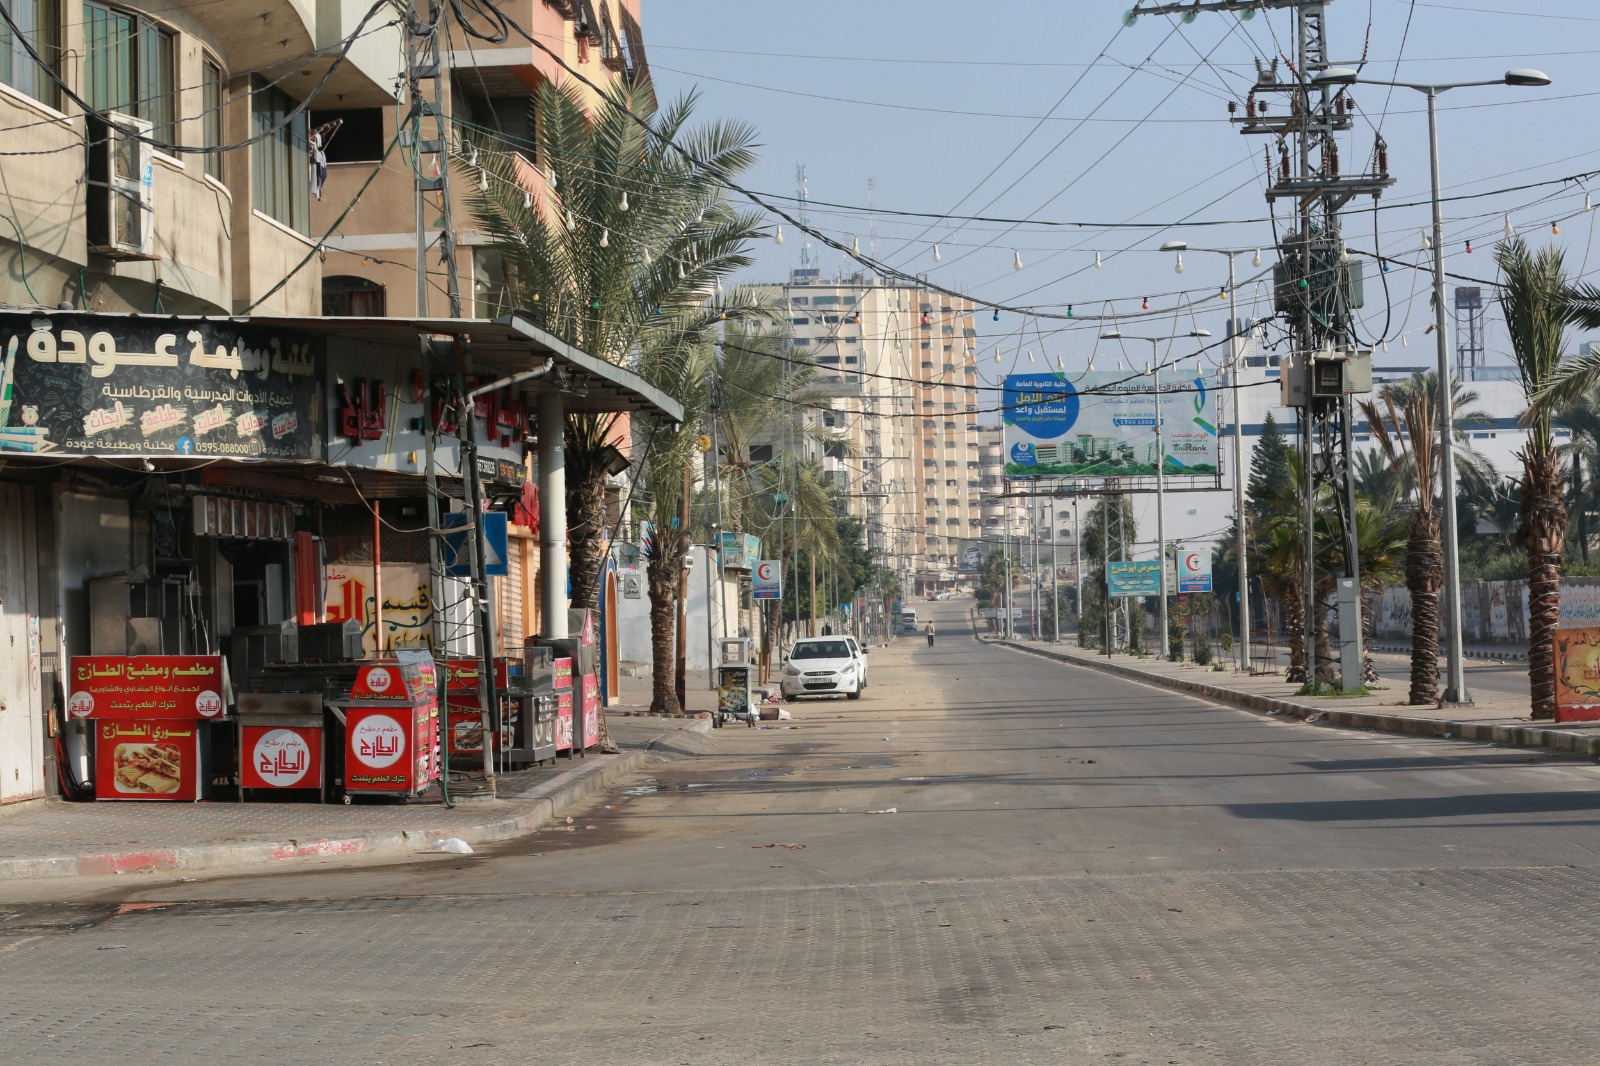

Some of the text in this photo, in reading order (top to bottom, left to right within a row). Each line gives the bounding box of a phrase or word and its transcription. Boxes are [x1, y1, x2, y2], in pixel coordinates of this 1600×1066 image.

[27, 318, 178, 378] عودة
[187, 330, 270, 381] ومطبعة
[102, 382, 181, 401] والقرطاسية
[184, 385, 234, 403] المدرسية
[235, 387, 267, 405] الأدوات
[145, 405, 178, 427] طباعة
[1015, 405, 1067, 415] لمستقبل واعد
[66, 437, 175, 452] مكتبة ومطبعة عودة
[195, 442, 249, 454] 0595-088000
[371, 584, 430, 614] قسم
[77, 662, 215, 681] مطعم ومطبخ الطازج
[89, 685, 200, 694] لجميع أنواع المشاوي والشاورما
[110, 700, 176, 711] نترك الطعم يتحدث
[102, 722, 192, 742] سوري الطازج
[360, 735, 399, 759] الطازج
[259, 748, 306, 777] الطازج
[352, 774, 406, 784] نترك الطعم يتحدث
